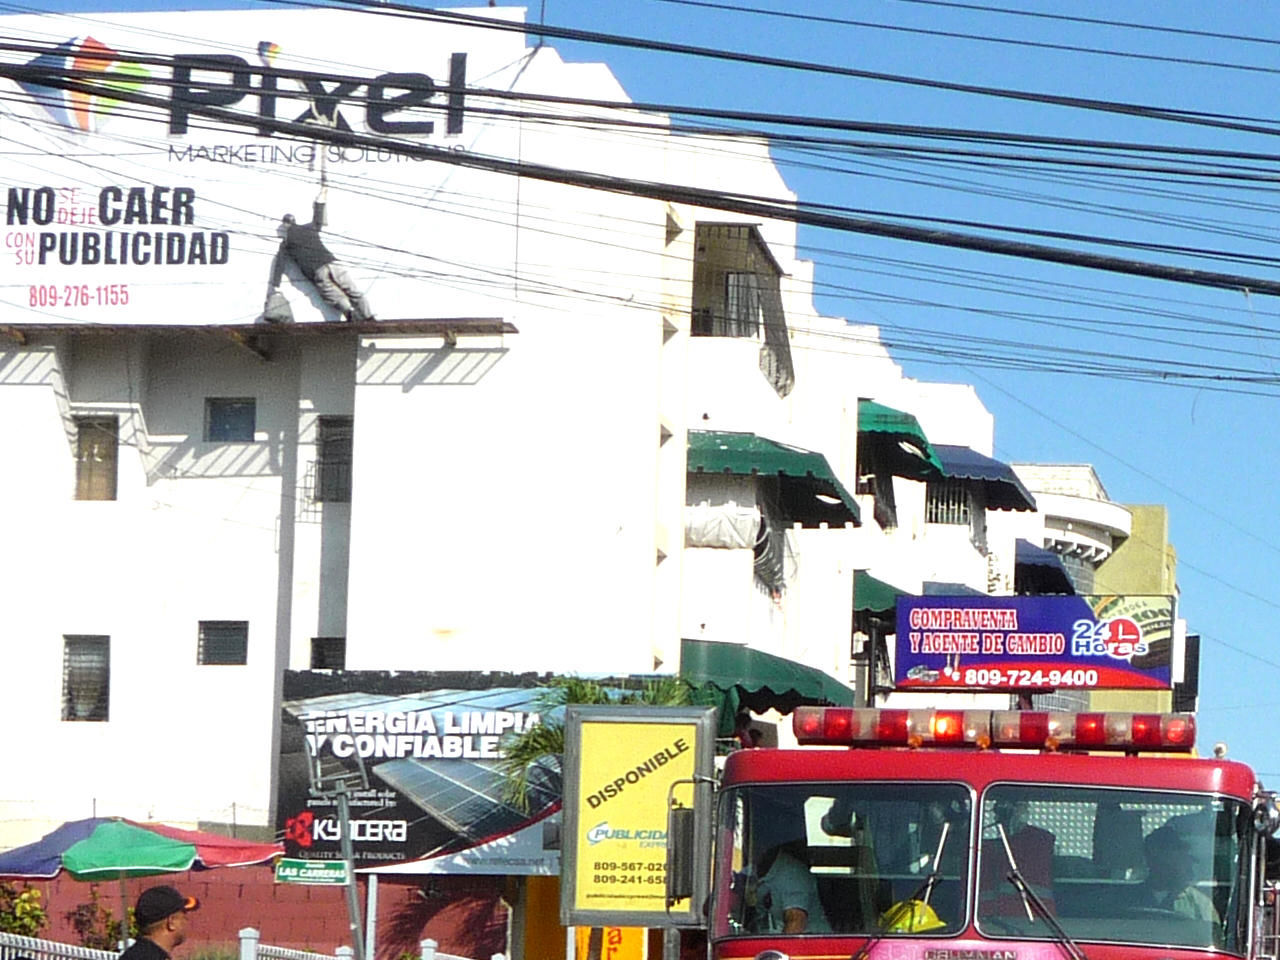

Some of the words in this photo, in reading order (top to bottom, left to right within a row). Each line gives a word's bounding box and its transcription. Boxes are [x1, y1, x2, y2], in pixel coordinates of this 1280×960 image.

[170, 42, 467, 137] Pixel
[168, 145, 314, 164] MARKETING
[7, 186, 55, 226] NO
[58, 187, 81, 204] SE
[99, 186, 196, 226] CAER
[58, 207, 96, 224] DEJE
[6, 232, 35, 248] CON
[38, 231, 230, 266] PUBLICIDAD
[16, 249, 35, 265] SU
[28, 285, 129, 307] 809-276-1155
[909, 608, 1018, 630] COMPRAVENTA
[1075, 620, 1112, 640] 24
[920, 632, 980, 654] AGENTE
[982, 633, 1004, 654] DE
[1007, 634, 1066, 655] CAMBIO
[1074, 639, 1147, 656] Horas
[965, 669, 1098, 686] 809-724-9400
[307, 710, 436, 734] ENERGIA
[306, 735, 327, 757] Y
[586, 737, 691, 810] DISPONIBLE
[279, 866, 298, 877] LAS
